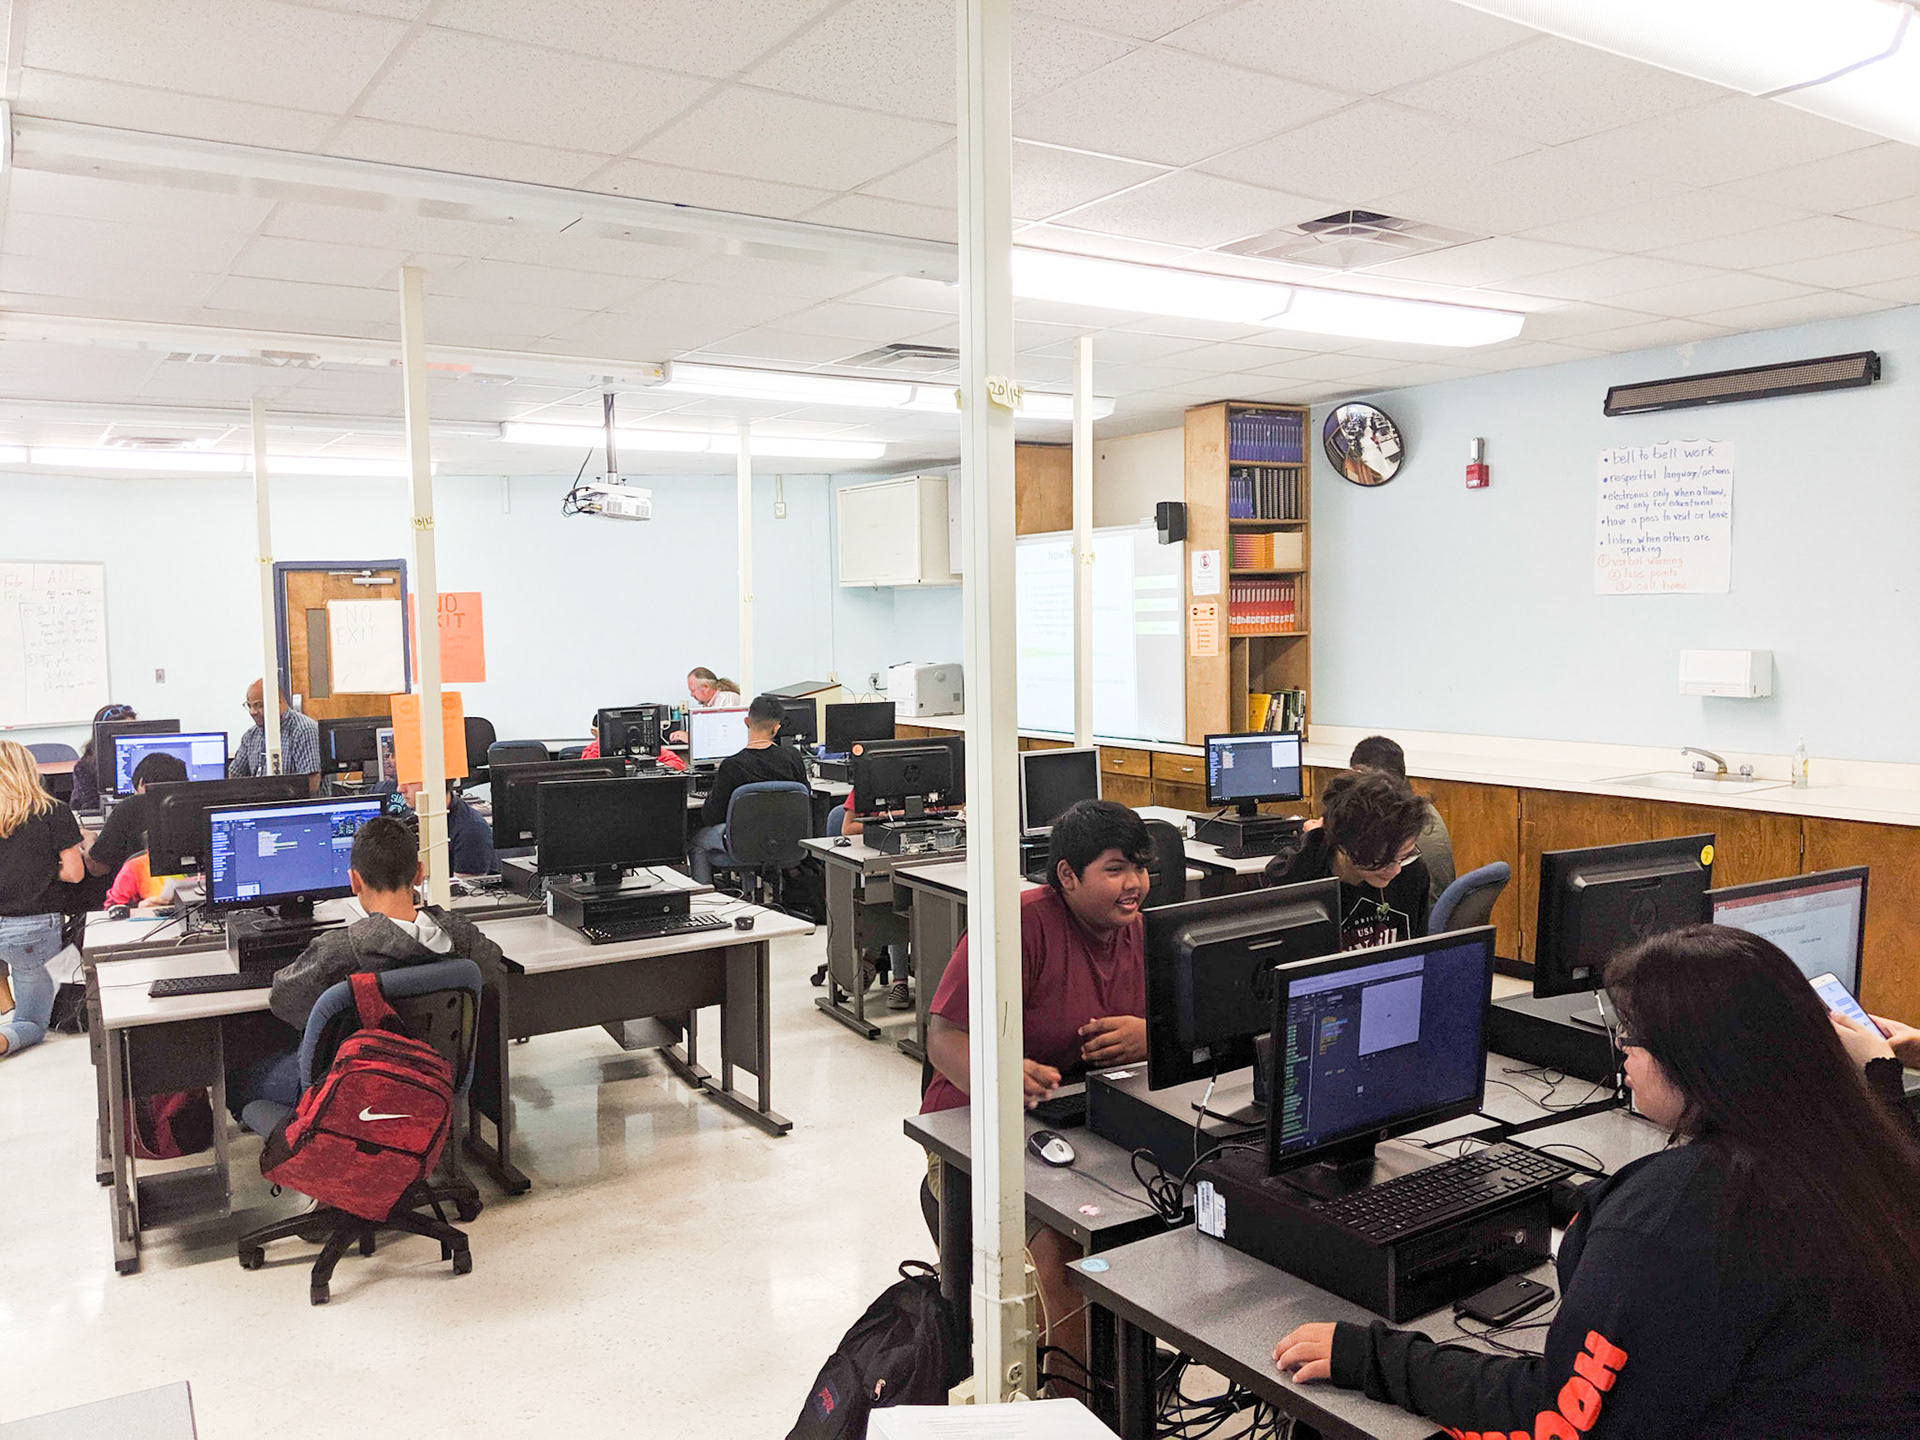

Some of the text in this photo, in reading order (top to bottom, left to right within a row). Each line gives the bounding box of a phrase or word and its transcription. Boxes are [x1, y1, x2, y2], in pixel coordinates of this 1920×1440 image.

[989, 380, 1021, 406] 20/14
[1613, 446, 1715, 464] bell to bell work
[1609, 469, 1656, 486] respectful
[1608, 488, 1649, 501] electronics
[1653, 487, 1669, 500] only
[1674, 486, 1695, 497] when
[1633, 500, 1649, 512] only
[1653, 499, 1666, 508] for
[1669, 498, 1713, 507] educational
[1607, 515, 1626, 527] have
[1639, 516, 1659, 530] pass
[1663, 509, 1671, 521] to
[1709, 510, 1728, 519] leave
[1608, 533, 1632, 545] listen
[1638, 531, 1660, 543] when
[1663, 531, 1690, 542] others
[1620, 545, 1661, 558] speaking
[438, 593, 458, 613] O
[345, 605, 373, 624] NO
[336, 625, 376, 646] EXIT
[1357, 926, 1374, 938] USA
